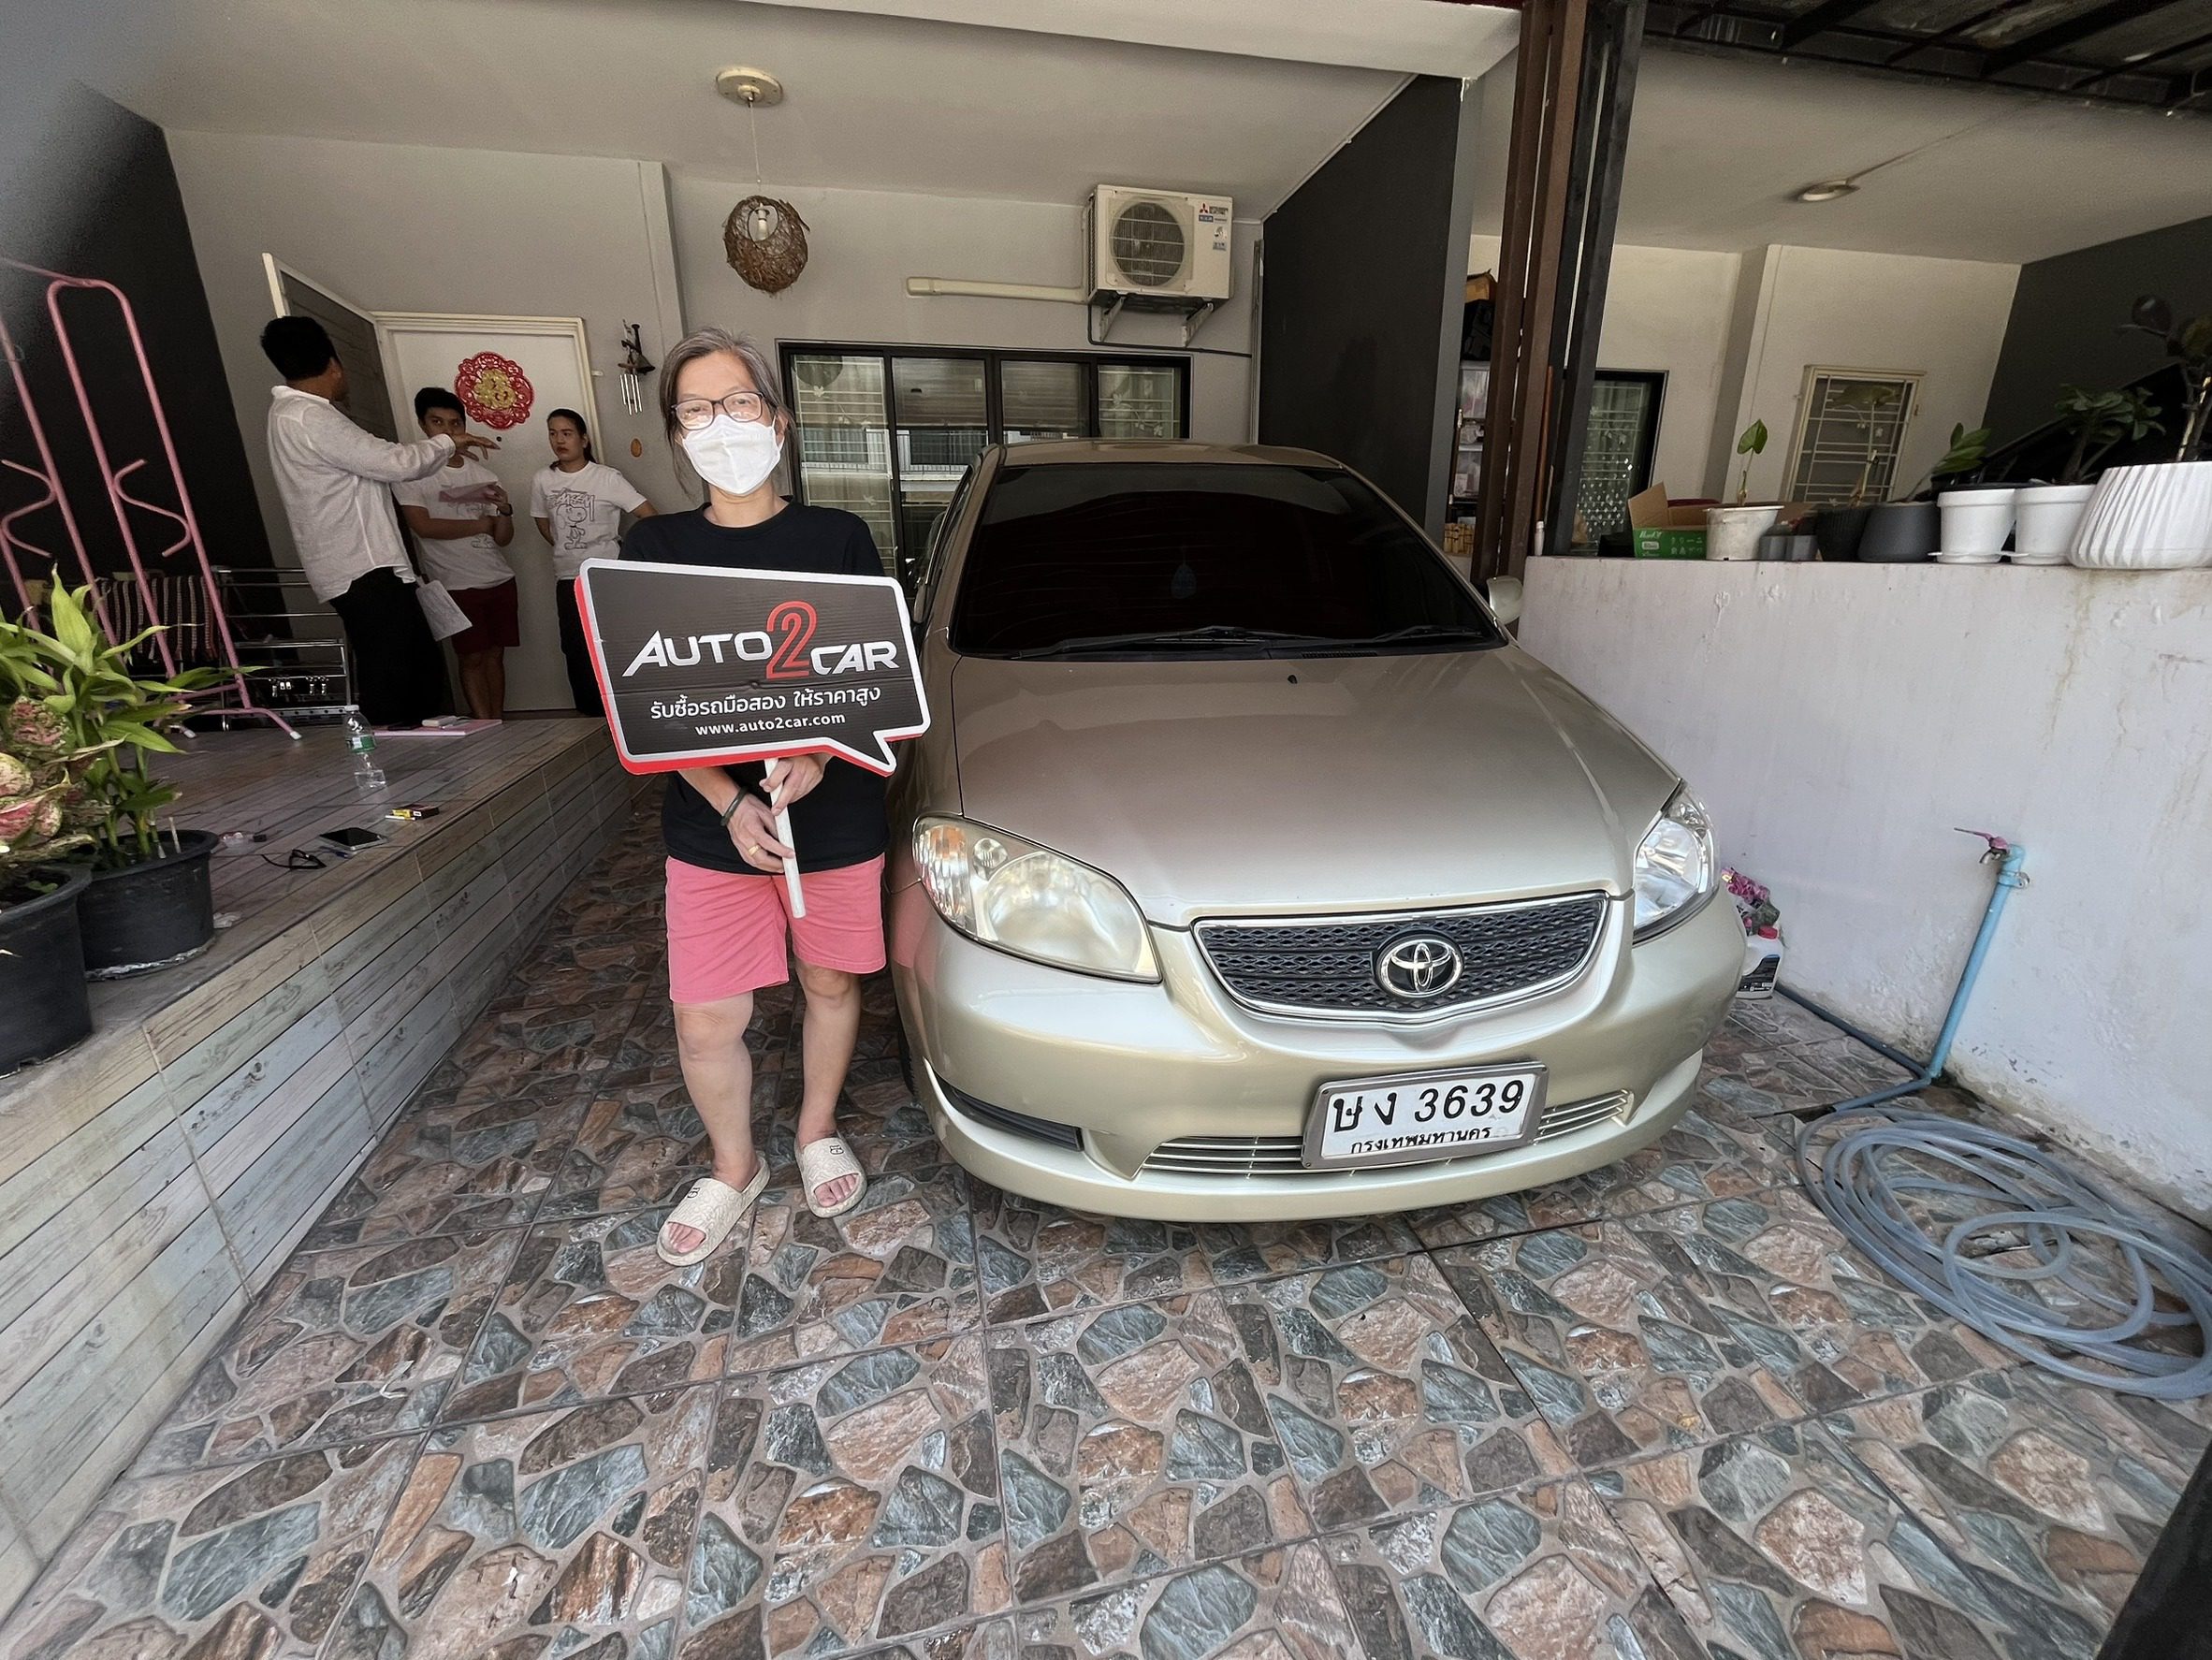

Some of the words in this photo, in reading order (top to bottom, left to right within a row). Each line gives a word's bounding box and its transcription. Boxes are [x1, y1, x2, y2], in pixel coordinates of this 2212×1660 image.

[650, 693, 786, 720] รับซื้อรถมือสอง
[793, 687, 881, 708] ให้ราคาสูง
[694, 714, 846, 736] www.auto2car.com
[1414, 1079, 1524, 1122] 3639
[1350, 1126, 1492, 1155] กรงเทพมหานคร
